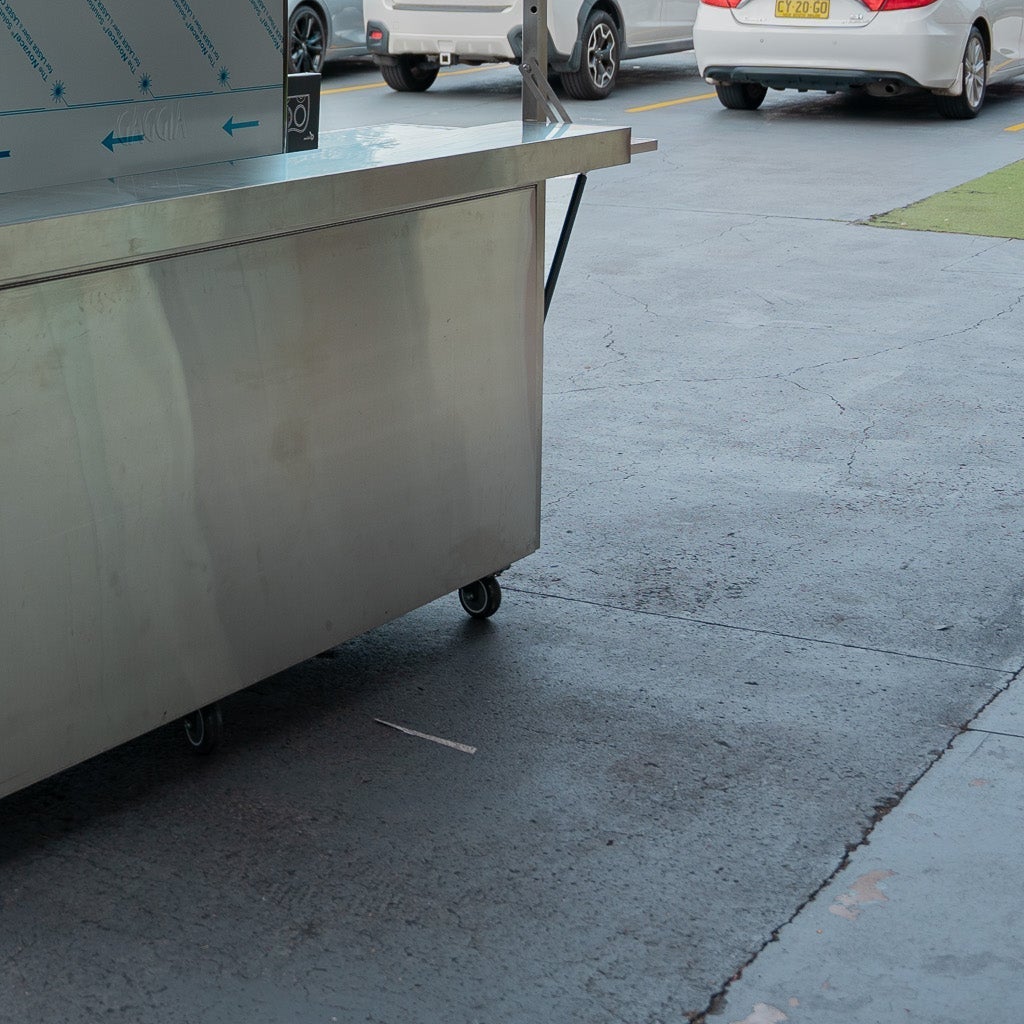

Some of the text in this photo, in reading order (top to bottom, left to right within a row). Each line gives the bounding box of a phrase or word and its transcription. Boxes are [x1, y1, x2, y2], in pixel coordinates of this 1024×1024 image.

[5, 3, 20, 26] LASER
[97, 0, 111, 21] LASER
[22, 28, 34, 44] Fiber
[112, 22, 124, 39] Fiber
[122, 37, 136, 59] LASER
[202, 32, 215, 52] LASER
[33, 42, 47, 65] LASER
[207, 53, 216, 68] The
[39, 66, 48, 82] The
[128, 60, 136, 75] The
